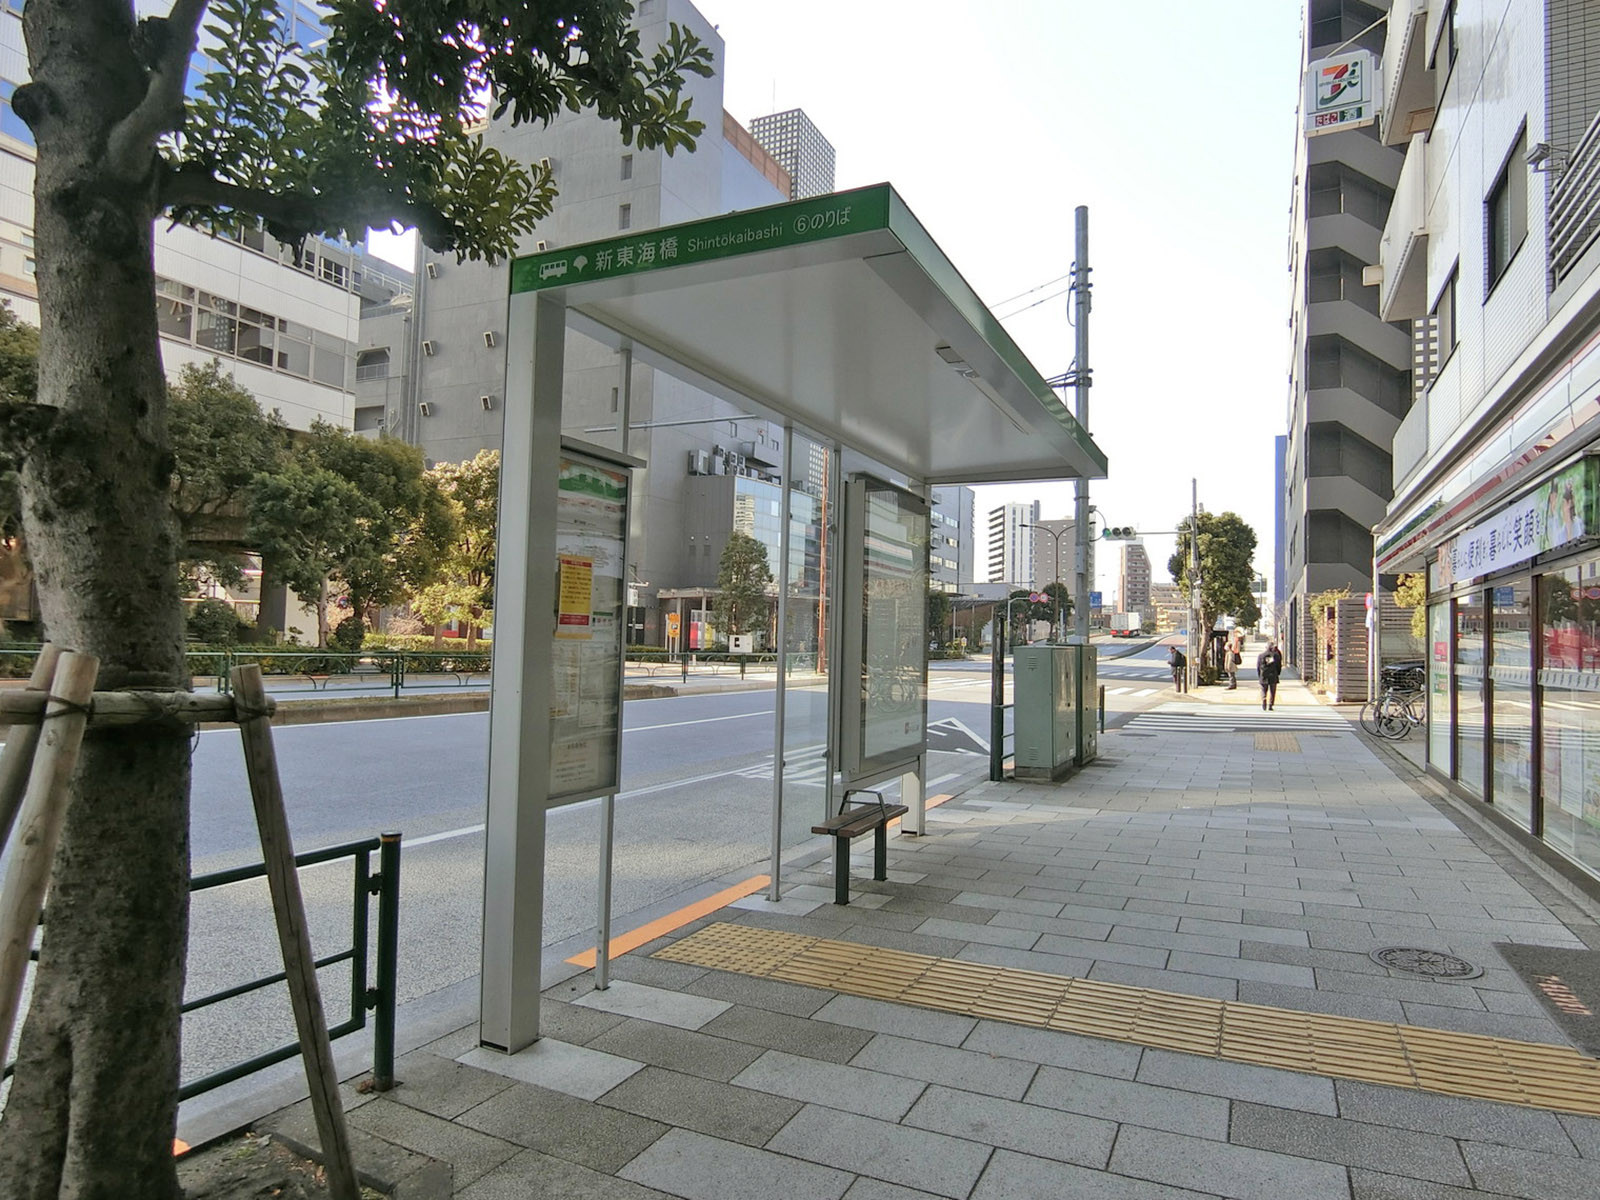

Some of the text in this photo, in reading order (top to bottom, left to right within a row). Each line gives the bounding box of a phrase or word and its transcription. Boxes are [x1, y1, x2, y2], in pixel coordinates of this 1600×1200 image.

[594, 236, 679, 271] 新東海橋
[686, 222, 783, 253] Shintōkaibashi
